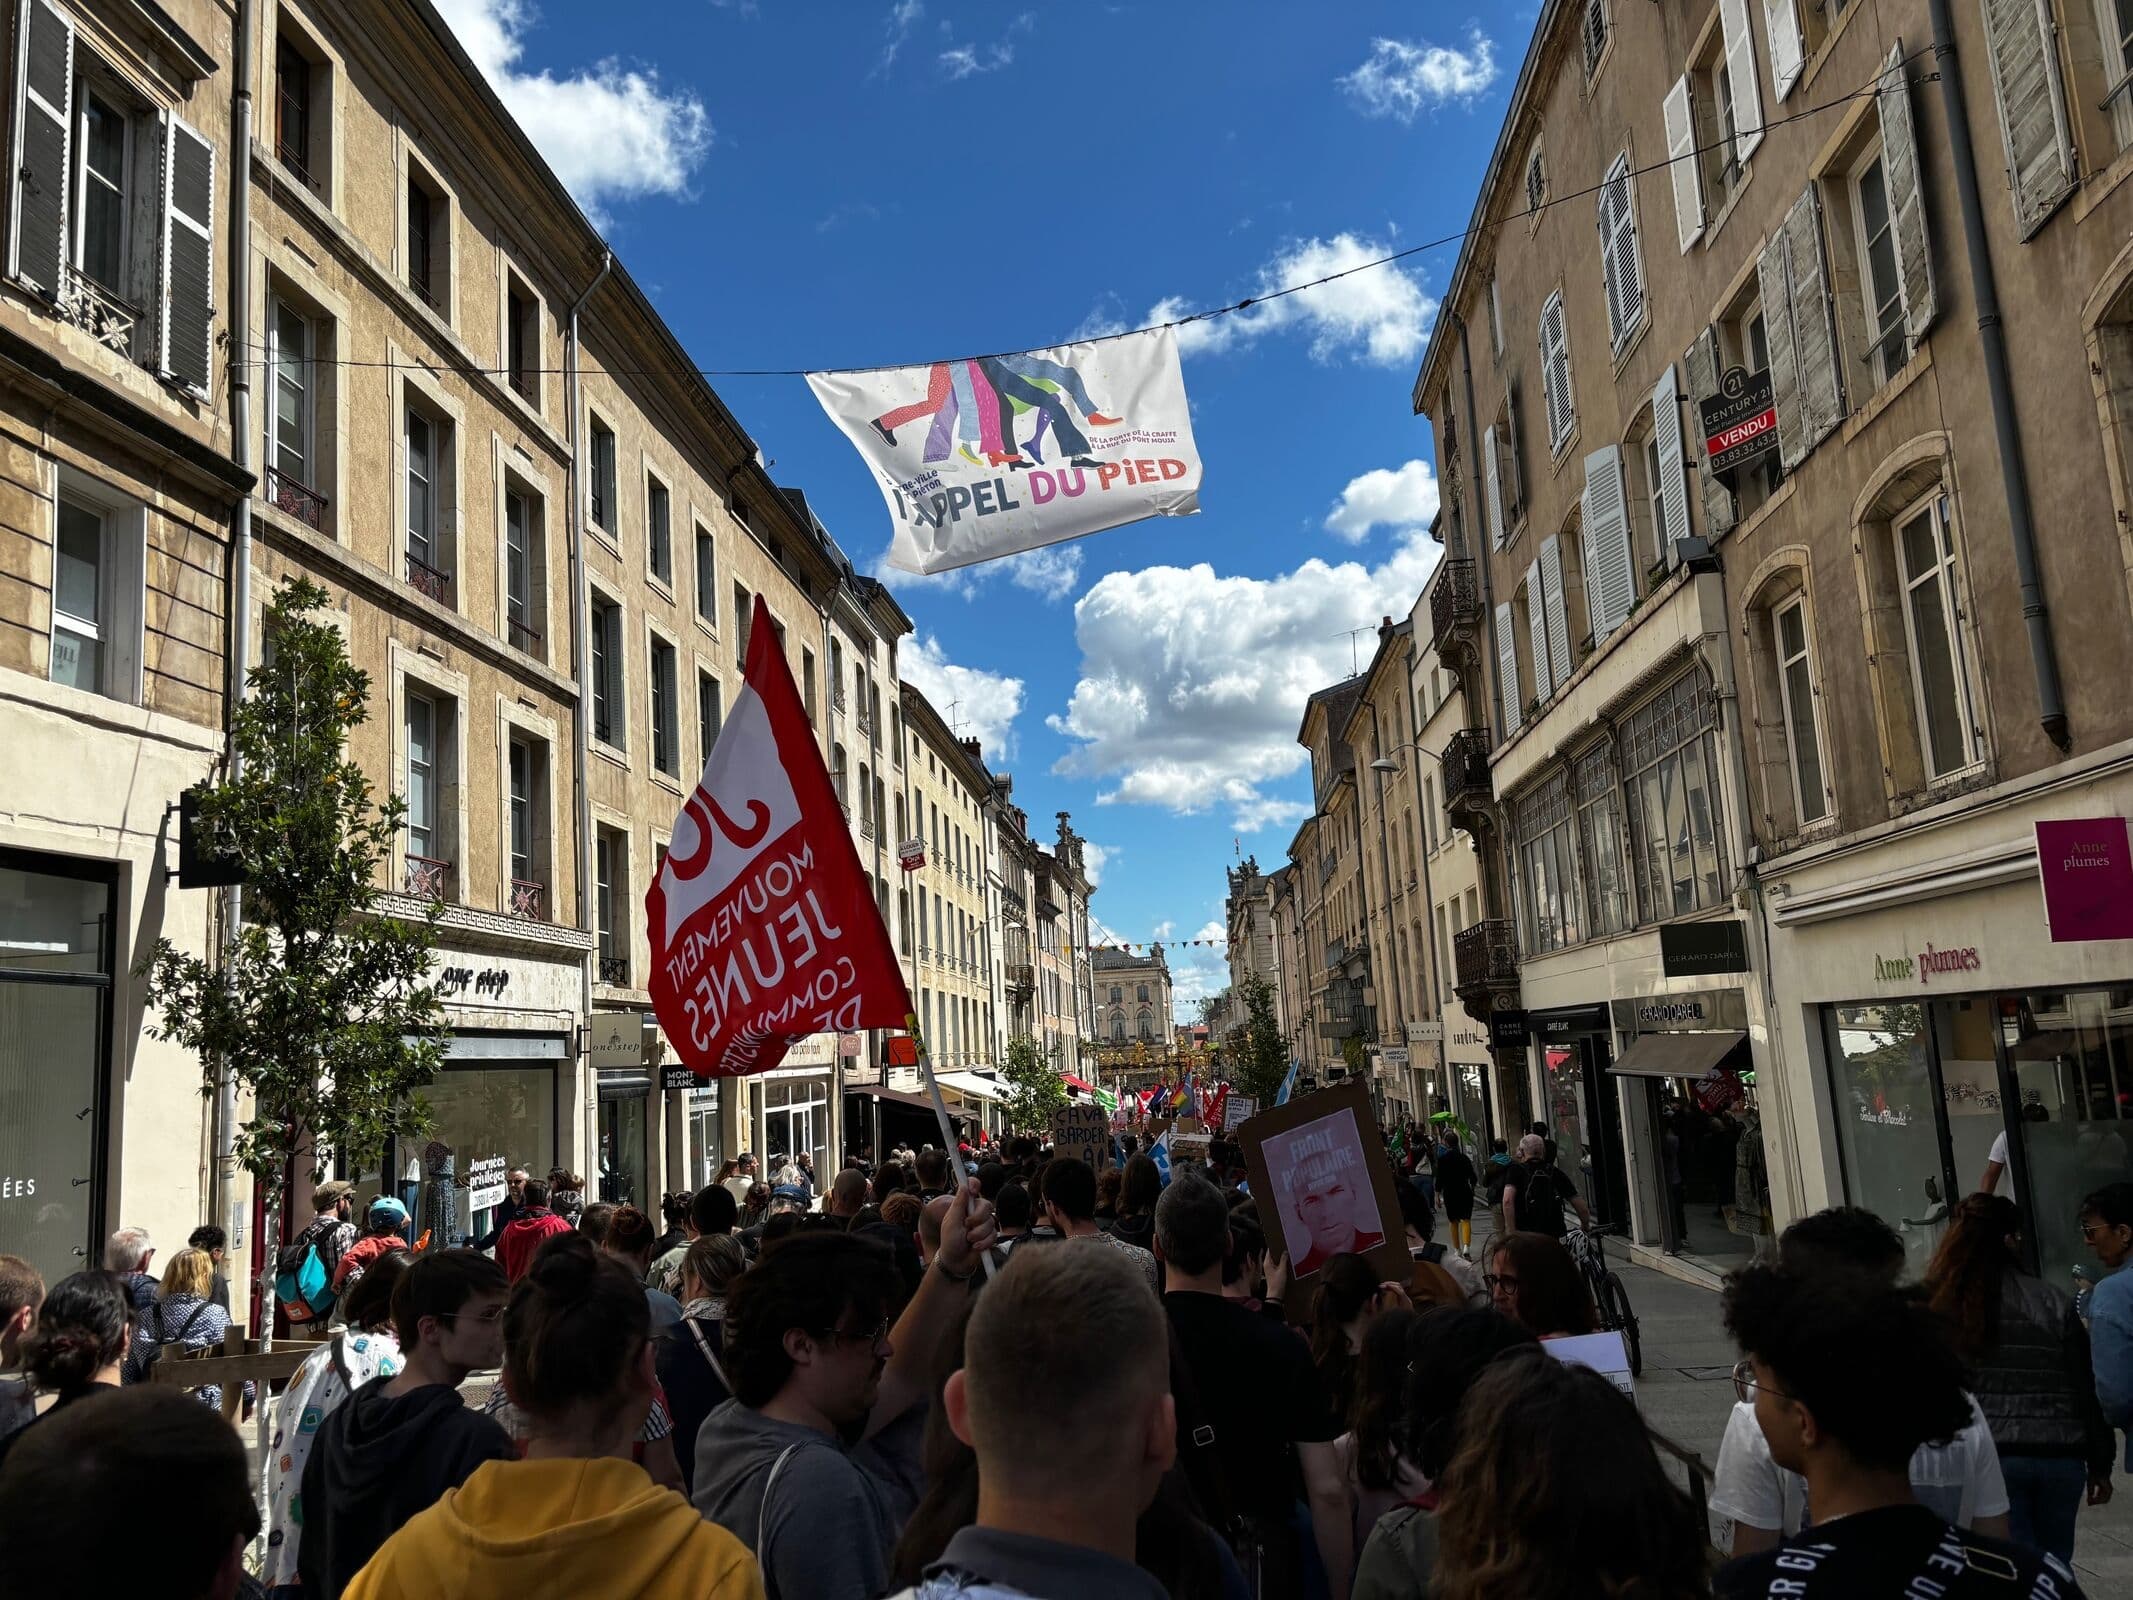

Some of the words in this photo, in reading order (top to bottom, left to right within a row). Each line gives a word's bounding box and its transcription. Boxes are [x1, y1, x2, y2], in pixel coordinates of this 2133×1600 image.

[1705, 393, 1758, 426] CENTURY
[1760, 386, 1771, 400] 21
[1109, 432, 1131, 442] PORTE
[1719, 415, 1768, 447] VENDU
[1106, 439, 1120, 449] RUE
[1120, 436, 1132, 446] DU
[1712, 432, 1777, 468] 03.83.32.43.2
[1028, 467, 1087, 505] DU
[2071, 840, 2108, 853] Anne
[2063, 855, 2110, 871] plumes
[1874, 952, 1914, 981] Anne
[1918, 941, 1981, 983] plumes
[1640, 1004, 1669, 1020] GERARD
[1670, 1003, 1698, 1020] DAREL
[617, 1042, 640, 1052] step
[666, 1070, 694, 1080] MONT
[666, 1079, 695, 1088] BLANC
[1056, 1126, 1105, 1146] BARDER
[1290, 1128, 1333, 1164] FRONT
[469, 1153, 506, 1172] Journées
[1281, 1146, 1357, 1192] POPULAIRE
[469, 1169, 506, 1188] privilèges
